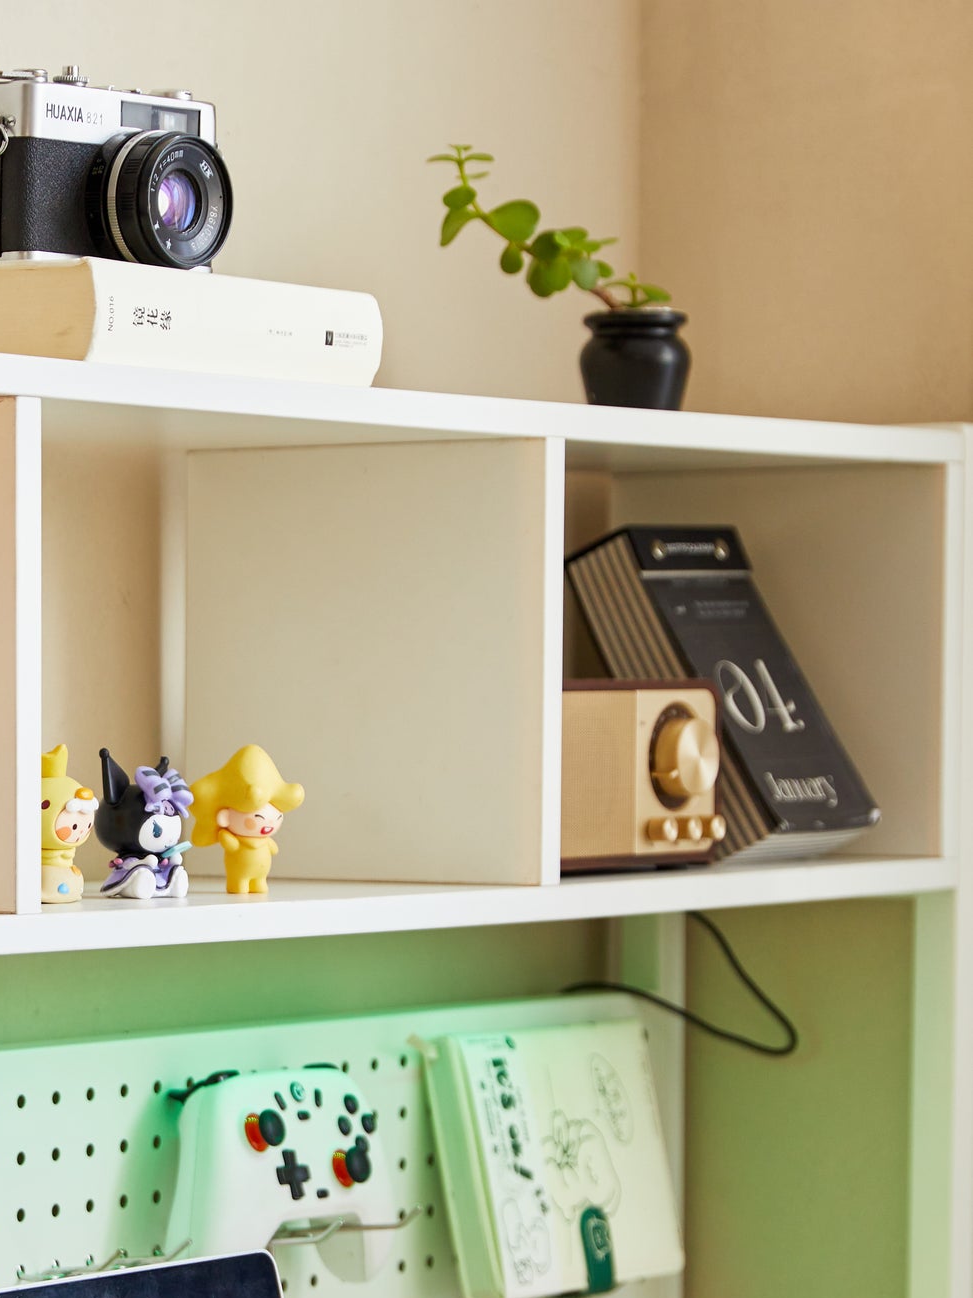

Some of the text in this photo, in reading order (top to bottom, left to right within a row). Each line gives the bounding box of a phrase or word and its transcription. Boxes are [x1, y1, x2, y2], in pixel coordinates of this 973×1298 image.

[45, 102, 103, 126] HUAXIA 821
[108, 295, 116, 331] NO.016
[714, 658, 806, 734] 04
[763, 771, 838, 808] January
